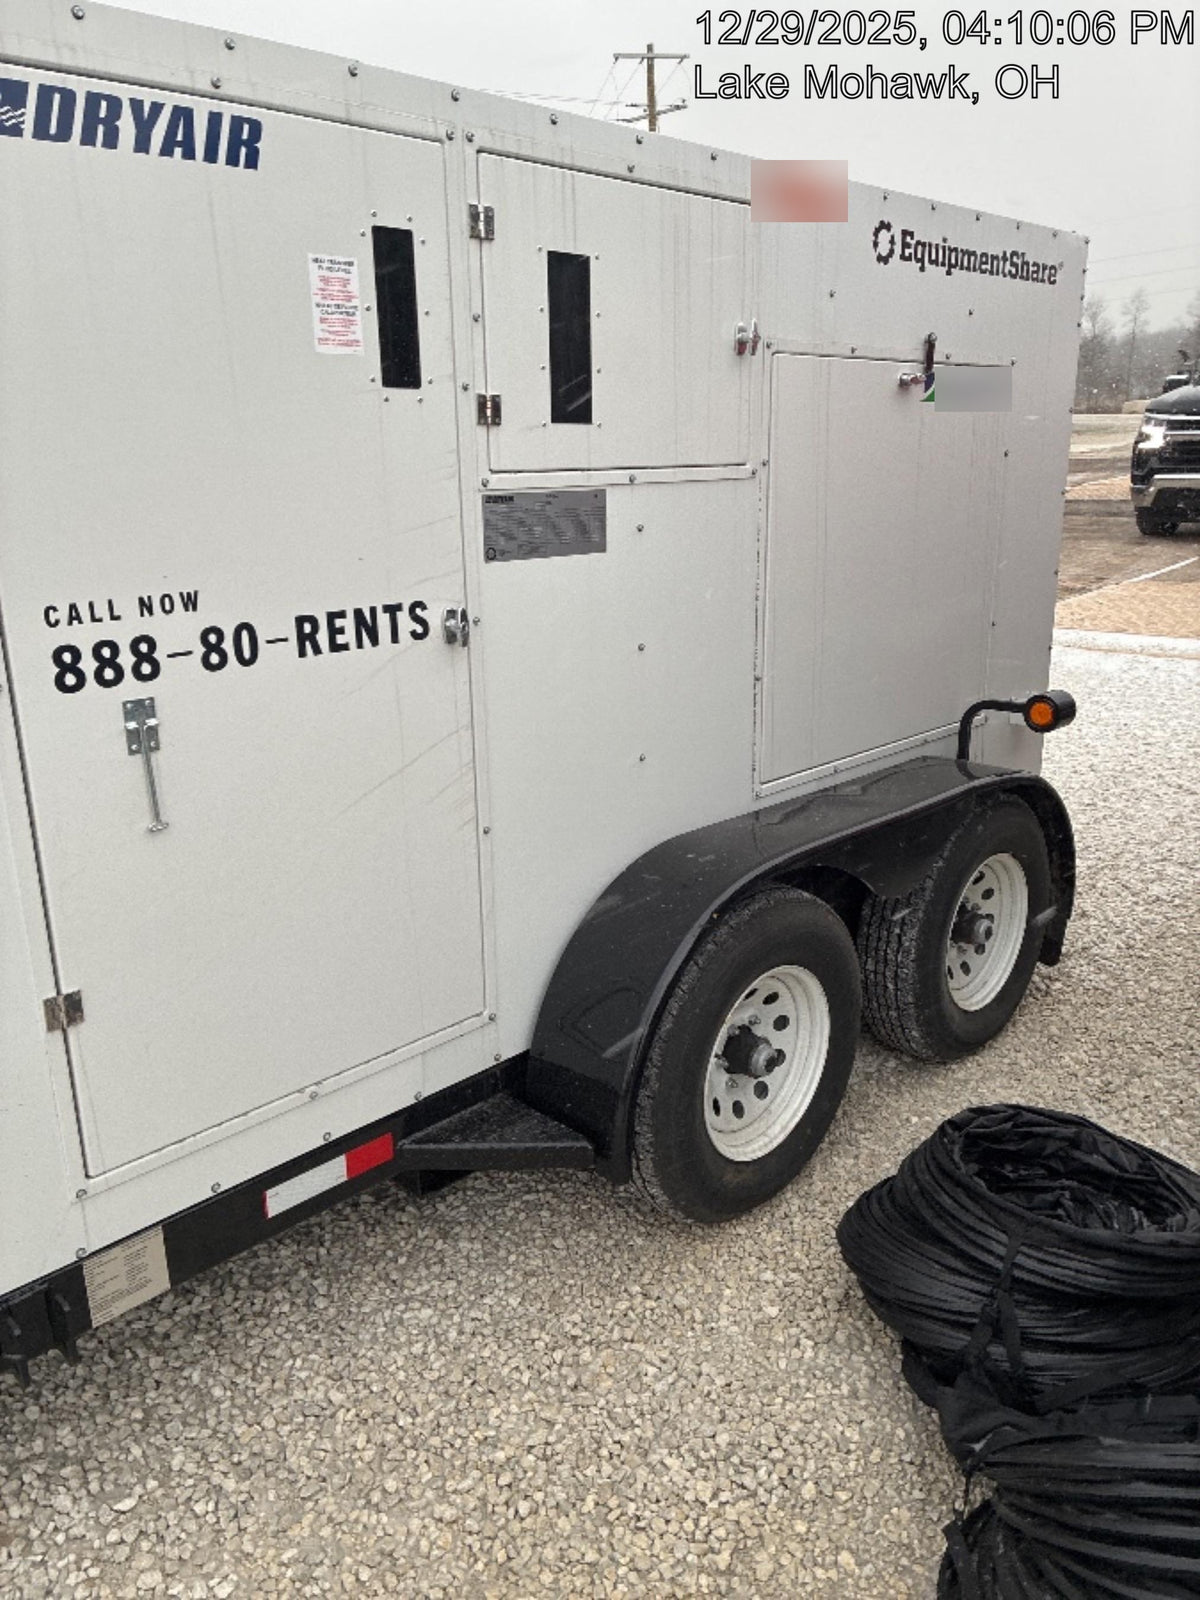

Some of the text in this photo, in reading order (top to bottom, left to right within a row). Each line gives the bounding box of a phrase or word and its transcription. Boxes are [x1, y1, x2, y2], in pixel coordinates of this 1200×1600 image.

[32, 84, 263, 170] DRYAIR
[899, 229, 1058, 285] EquipmentShare
[44, 590, 200, 628] CALL NOW
[51, 600, 430, 694] 888-80-RENTS
